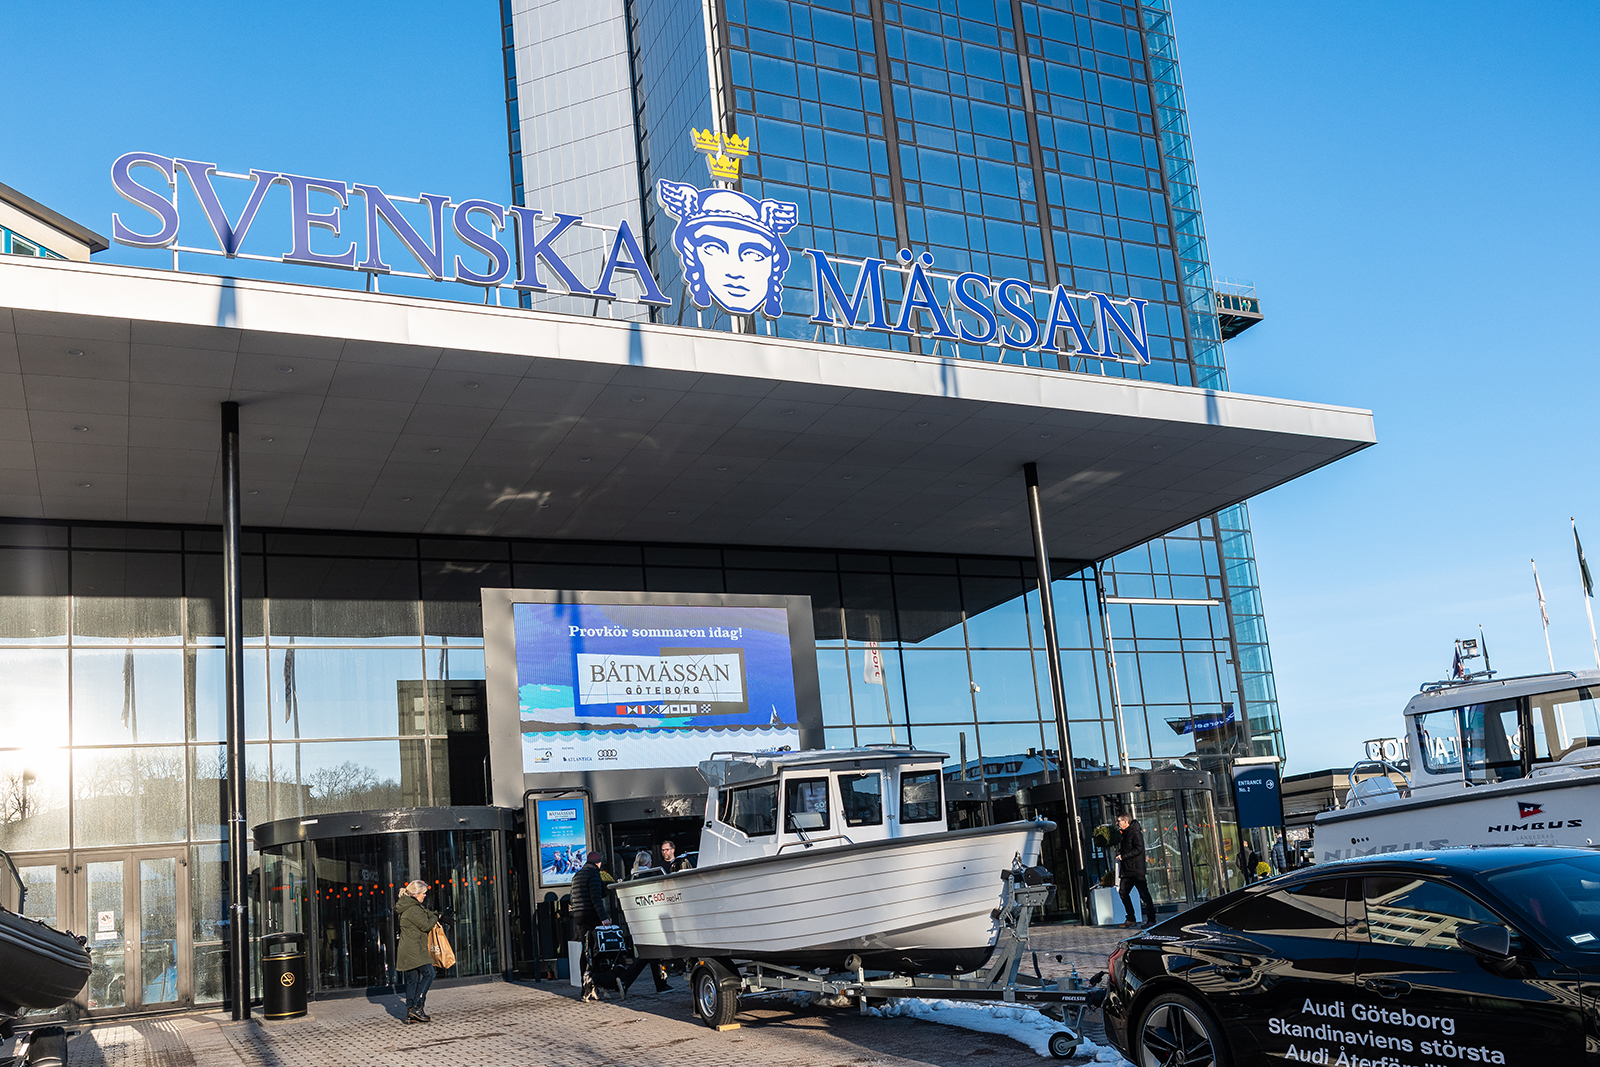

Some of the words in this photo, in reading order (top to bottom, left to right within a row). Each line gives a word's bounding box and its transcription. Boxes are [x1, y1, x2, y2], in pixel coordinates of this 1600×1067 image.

[110, 151, 672, 308] SVENSKA
[802, 247, 1151, 366] MÄSSAN
[568, 625, 629, 638] Provkör
[632, 628, 706, 638] sommaren
[709, 627, 743, 641] idag!
[589, 660, 730, 683] BÅTMÄSSAN
[625, 684, 700, 695] GÖTEBORG
[1487, 818, 1583, 834] NIMBUS
[1301, 998, 1346, 1019] Audi
[1351, 1002, 1456, 1036] Göteborg
[1267, 1016, 1414, 1053] Skandinaviens
[1420, 1040, 1506, 1065] största
[1284, 1043, 1329, 1065] Audi
